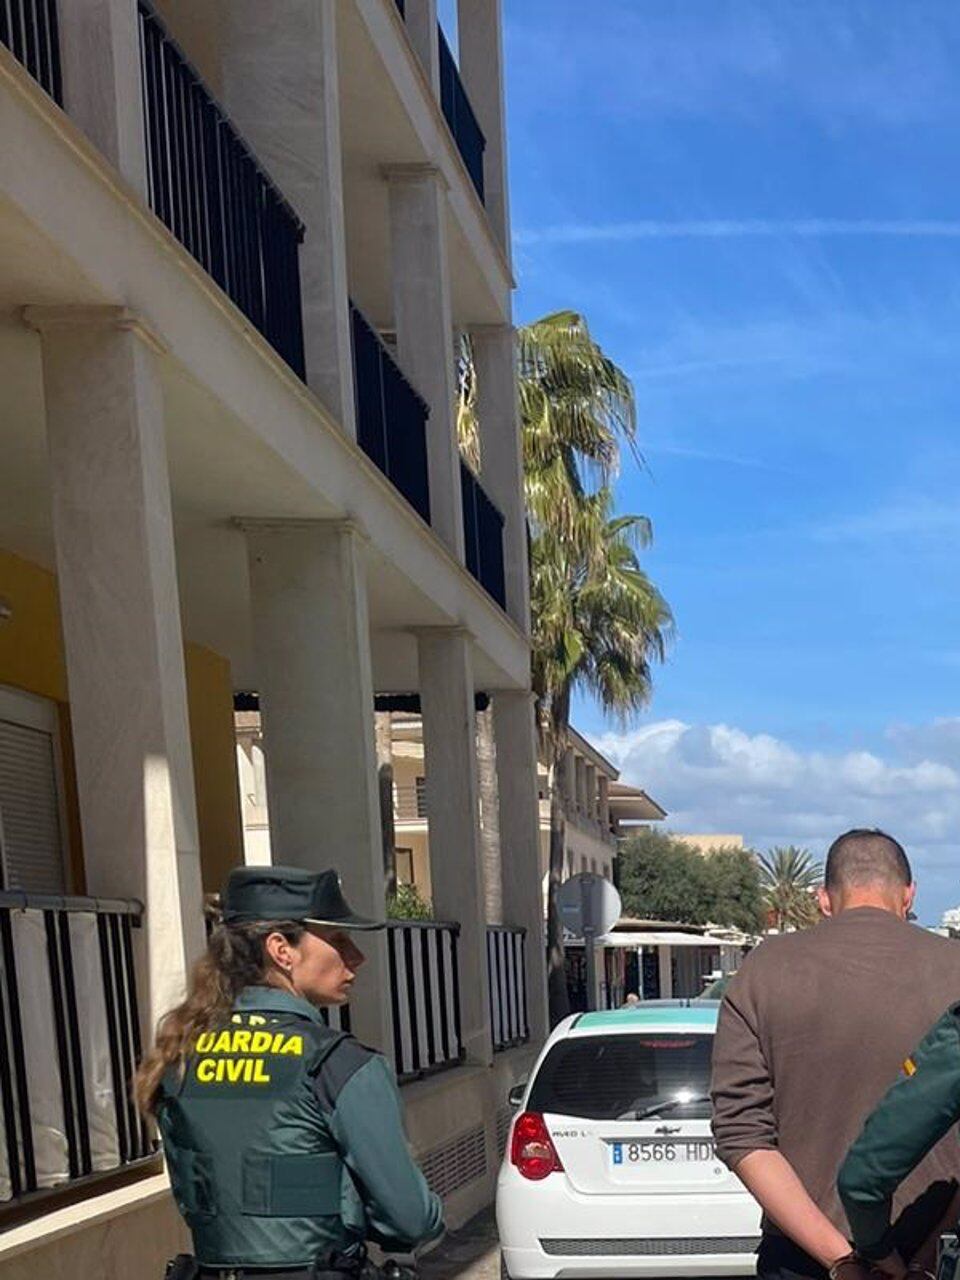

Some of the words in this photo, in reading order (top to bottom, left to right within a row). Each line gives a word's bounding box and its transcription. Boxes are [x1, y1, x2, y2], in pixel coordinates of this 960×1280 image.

[195, 1030, 303, 1055] UARDIA
[196, 1058, 270, 1082] CIVIL
[628, 1143, 677, 1162] 8566
